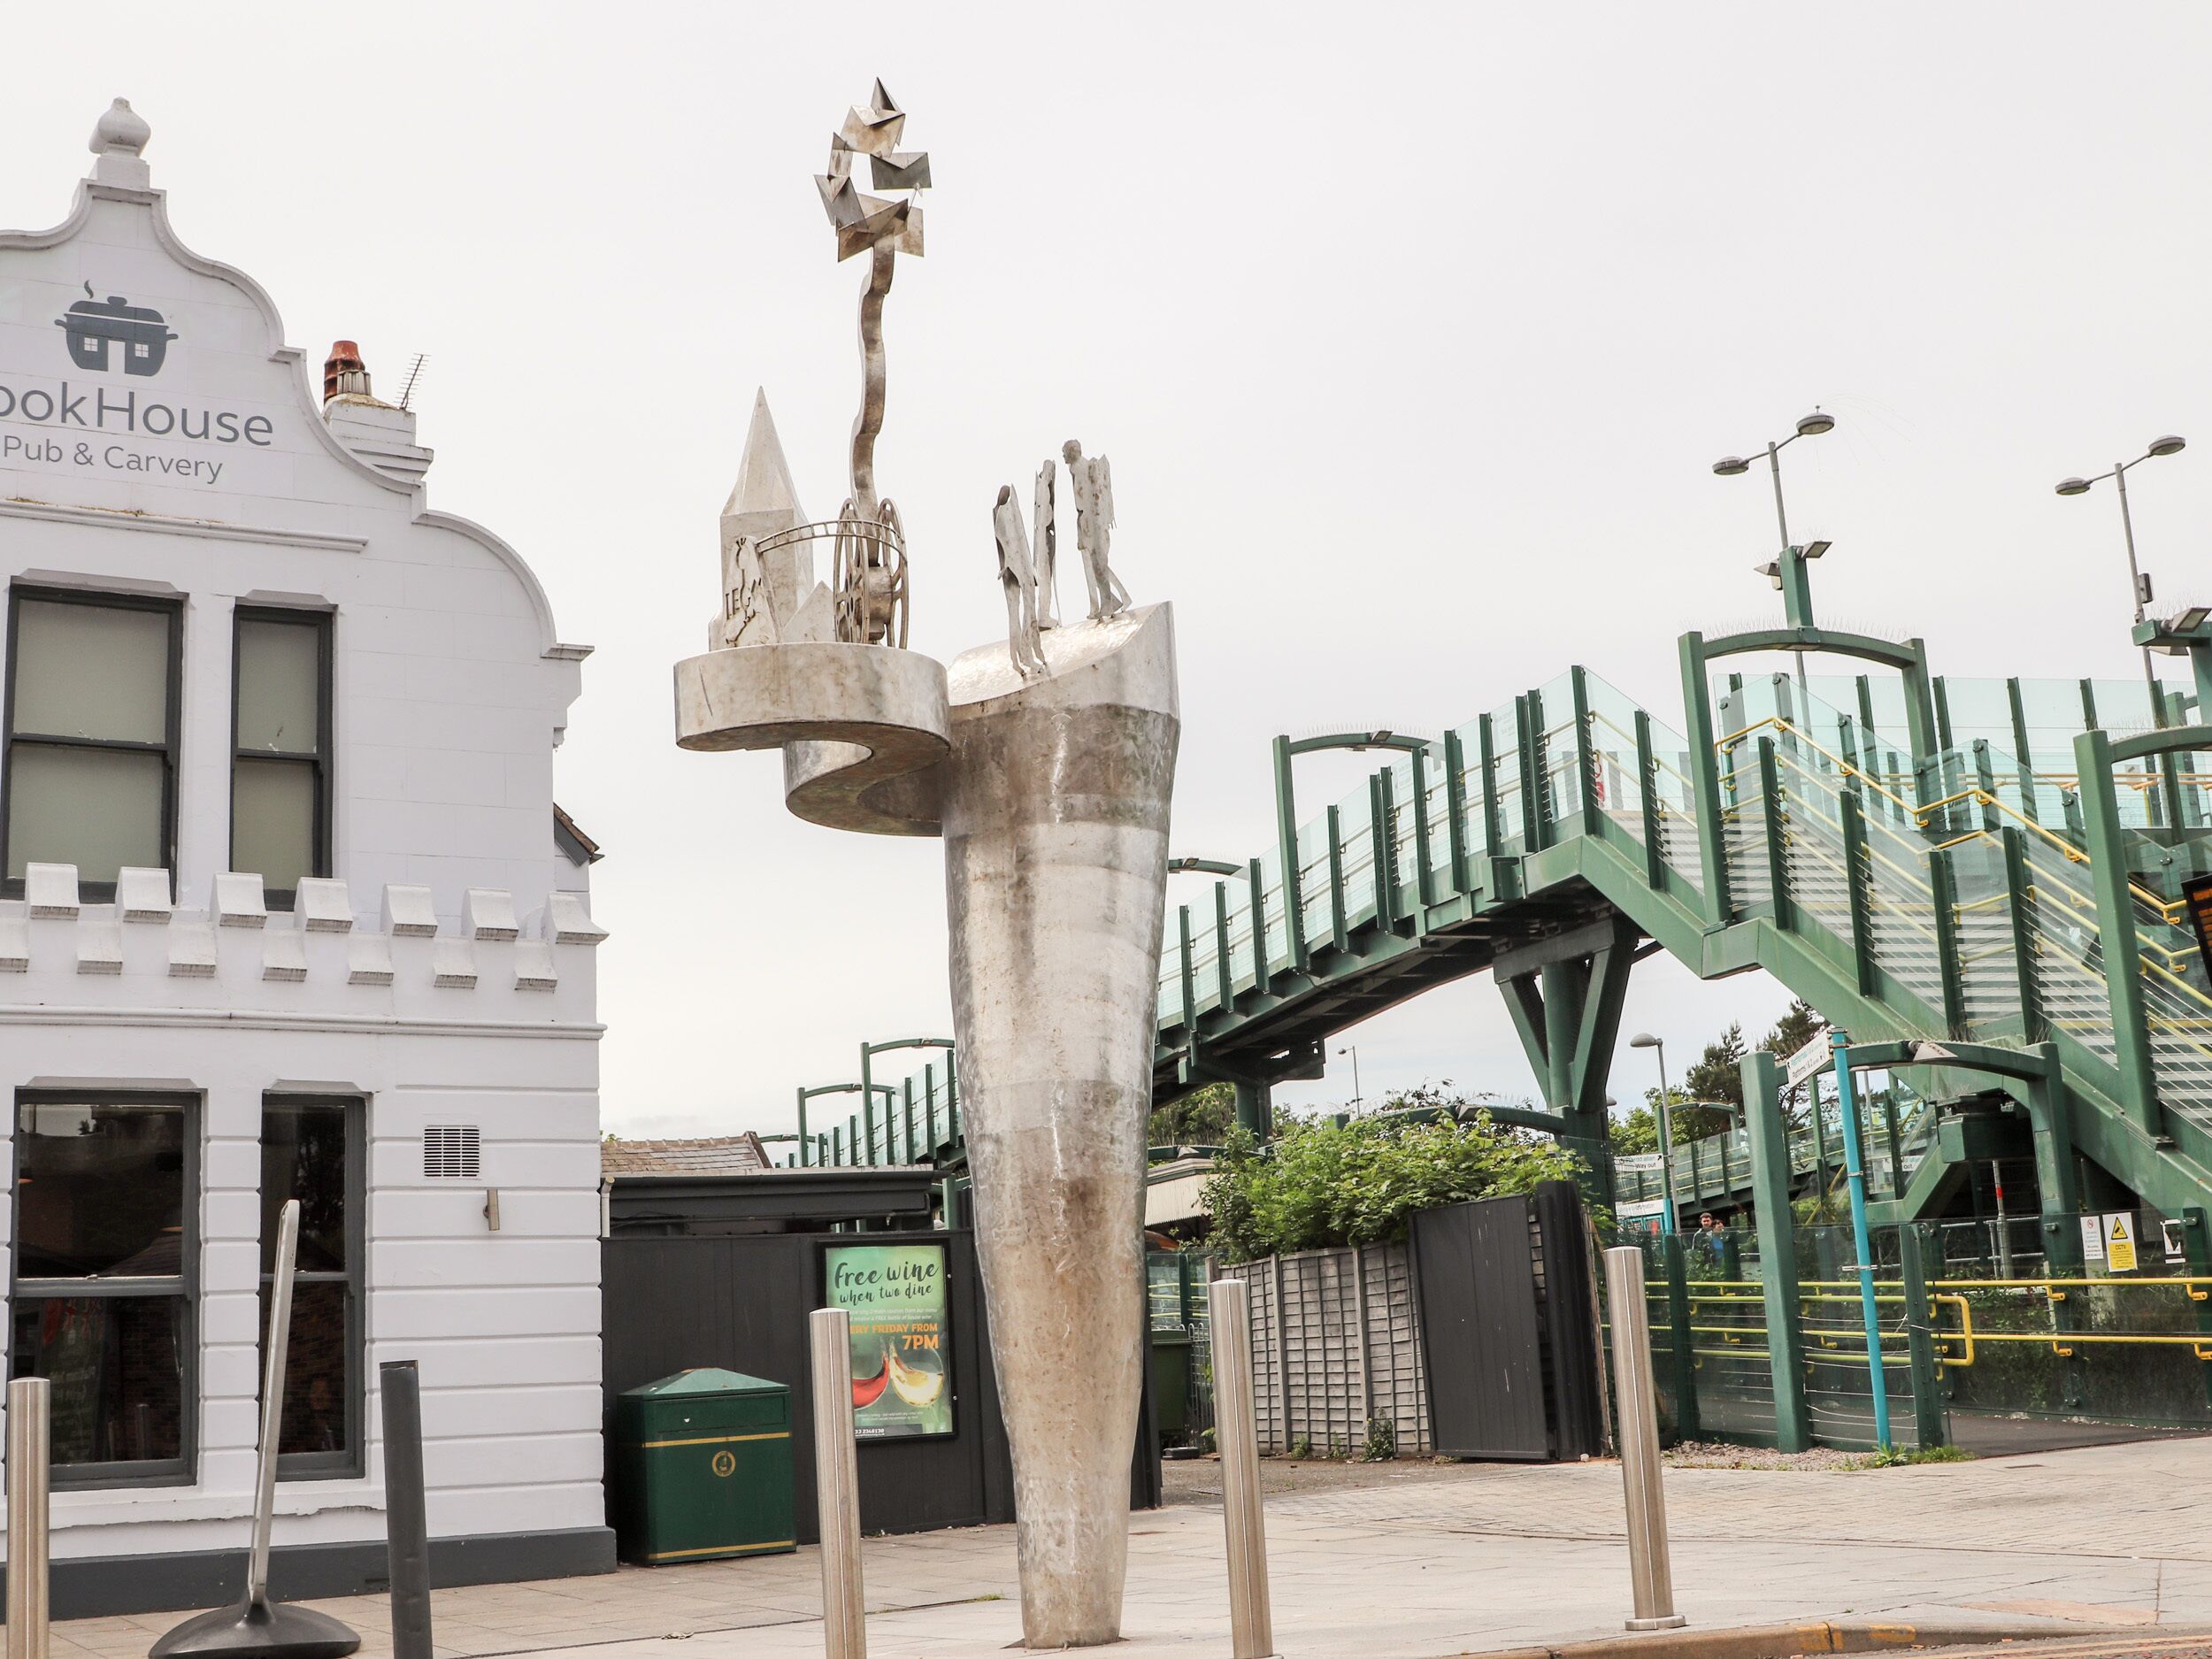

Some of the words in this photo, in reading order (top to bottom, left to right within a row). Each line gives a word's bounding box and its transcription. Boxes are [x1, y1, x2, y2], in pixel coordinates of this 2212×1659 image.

[4, 434, 63, 463] Pub
[73, 442, 94, 466] &
[104, 446, 223, 484] Carvery
[887, 1261, 939, 1281] wine
[840, 1289, 875, 1306] when
[879, 1286, 900, 1299] two
[905, 1282, 933, 1299] dine
[849, 1325, 869, 1334] ERY
[872, 1324, 909, 1333] FRIDAY
[911, 1323, 938, 1332] FROM
[902, 1334, 939, 1350] 7PM
